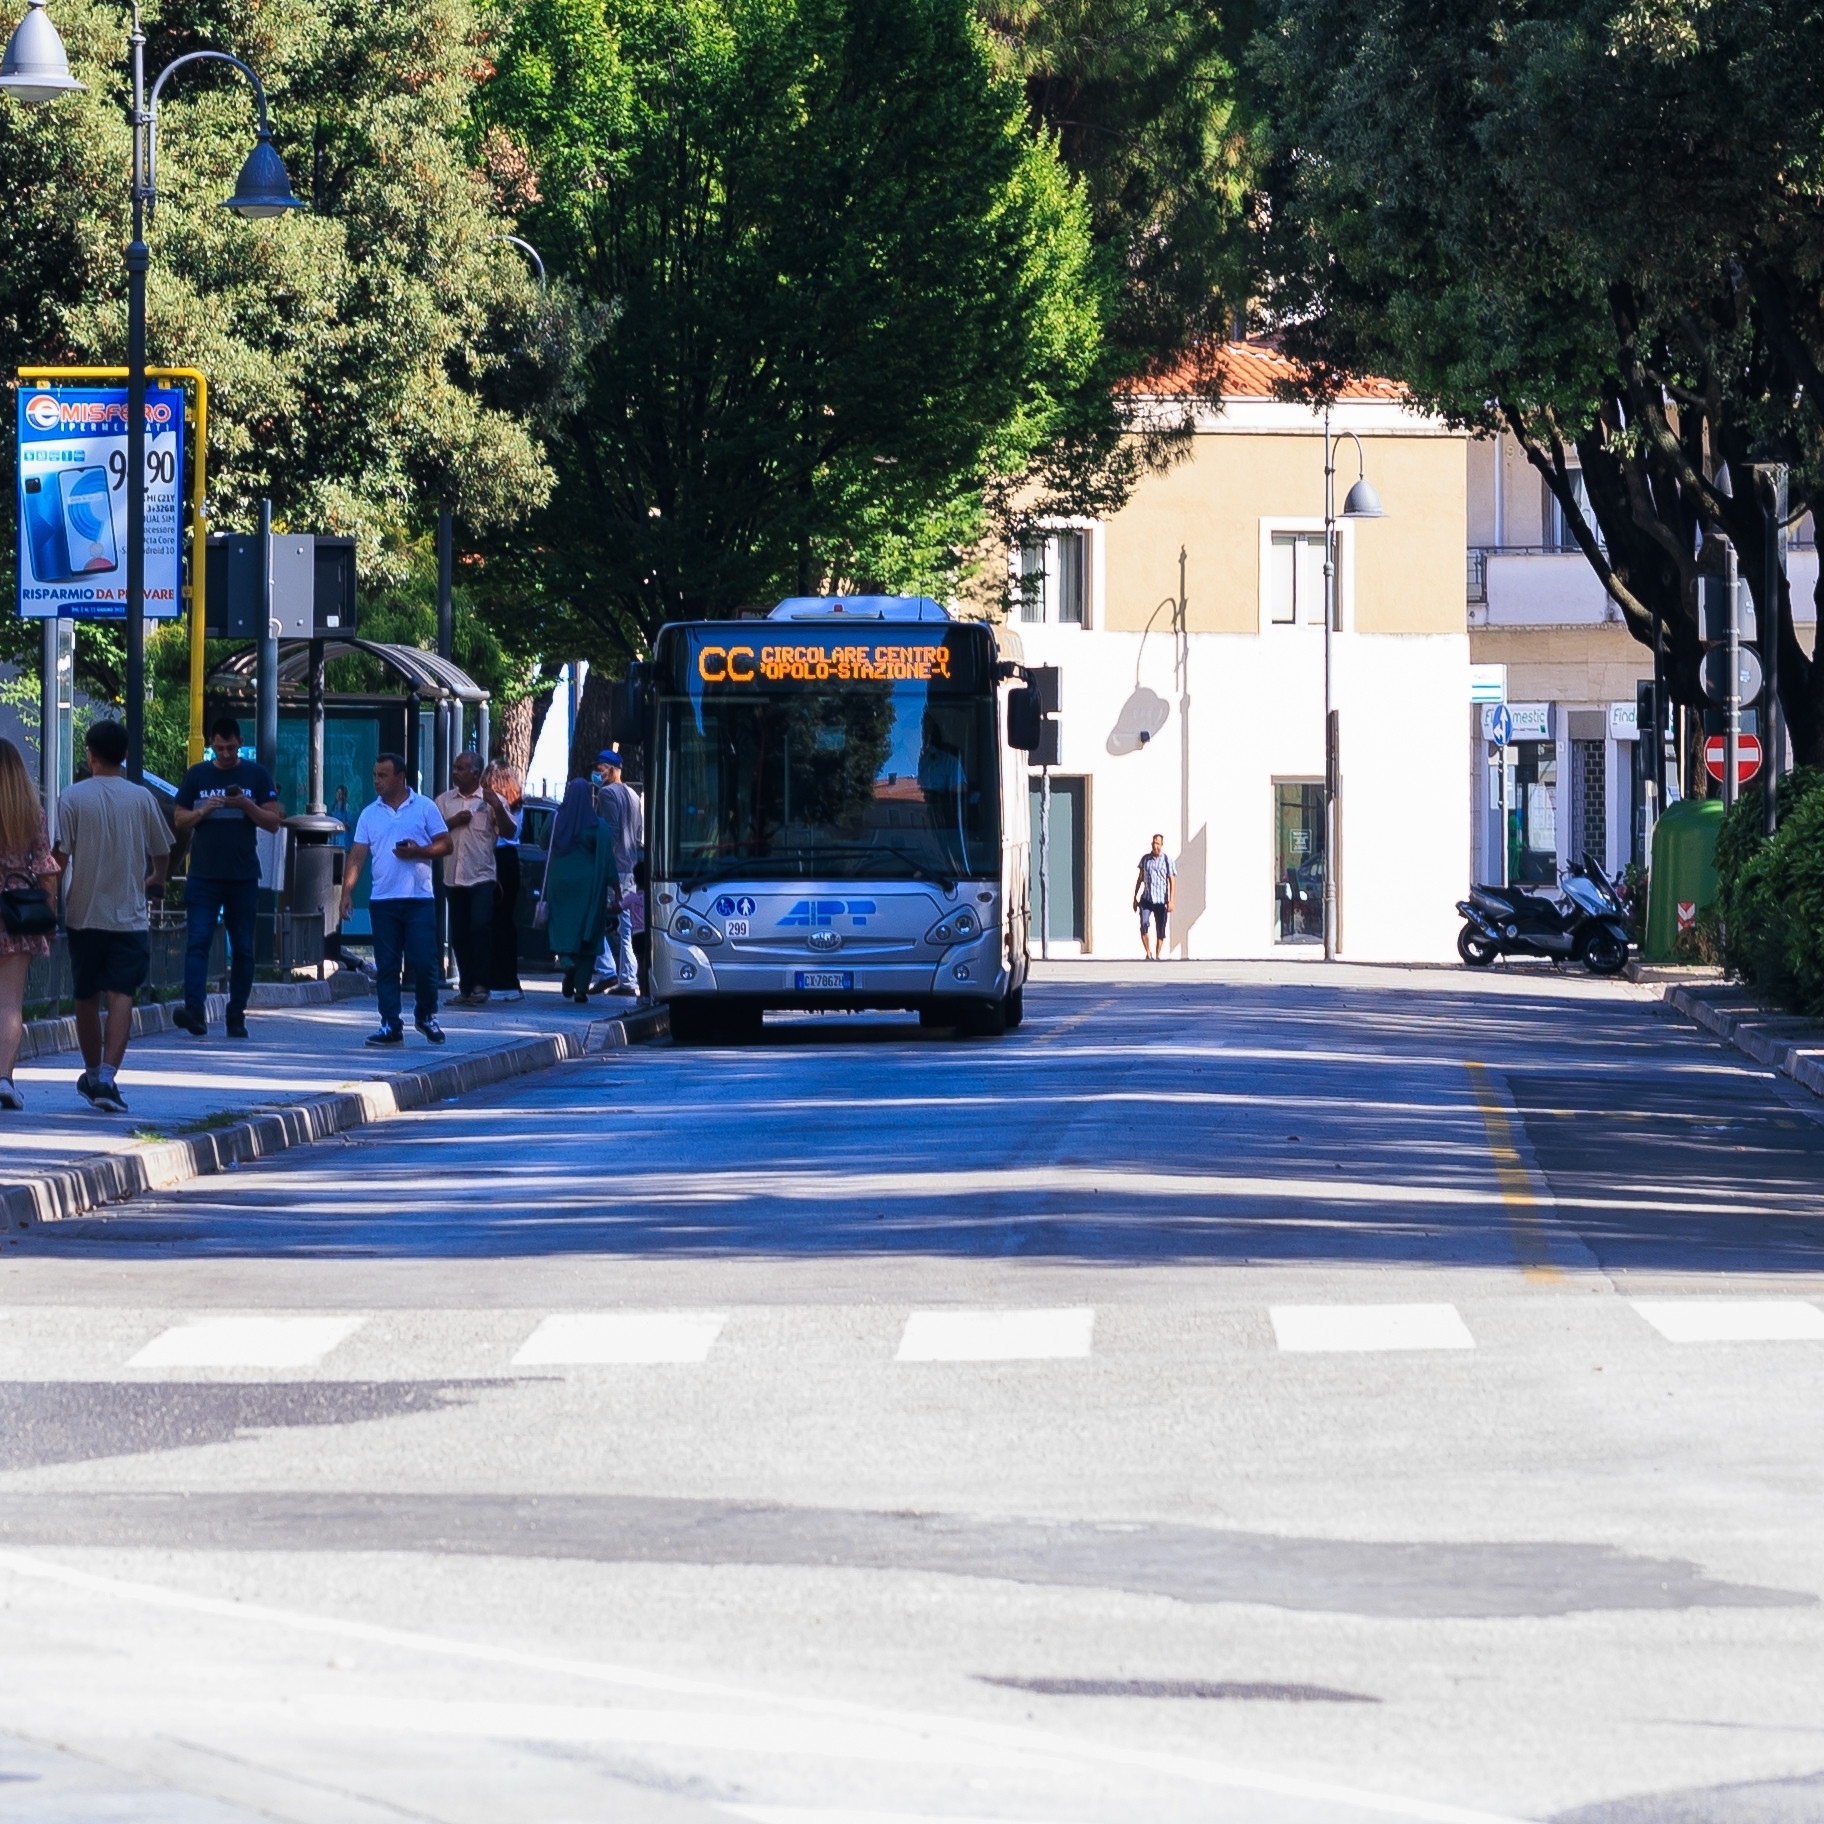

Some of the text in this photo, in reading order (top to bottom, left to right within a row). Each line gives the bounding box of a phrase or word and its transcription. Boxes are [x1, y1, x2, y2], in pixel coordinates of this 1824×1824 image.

[161, 515, 175, 523] SIM
[158, 536, 175, 544] Core
[23, 588, 174, 600] RISPARMIO DA PVARE
[698, 646, 950, 681] CC CIRCOLARE CENTRO
[760, 662, 951, 680] OPOLO-STAZIONE-
[200, 788, 252, 798] SLAZEER
[728, 922, 747, 936] 299
